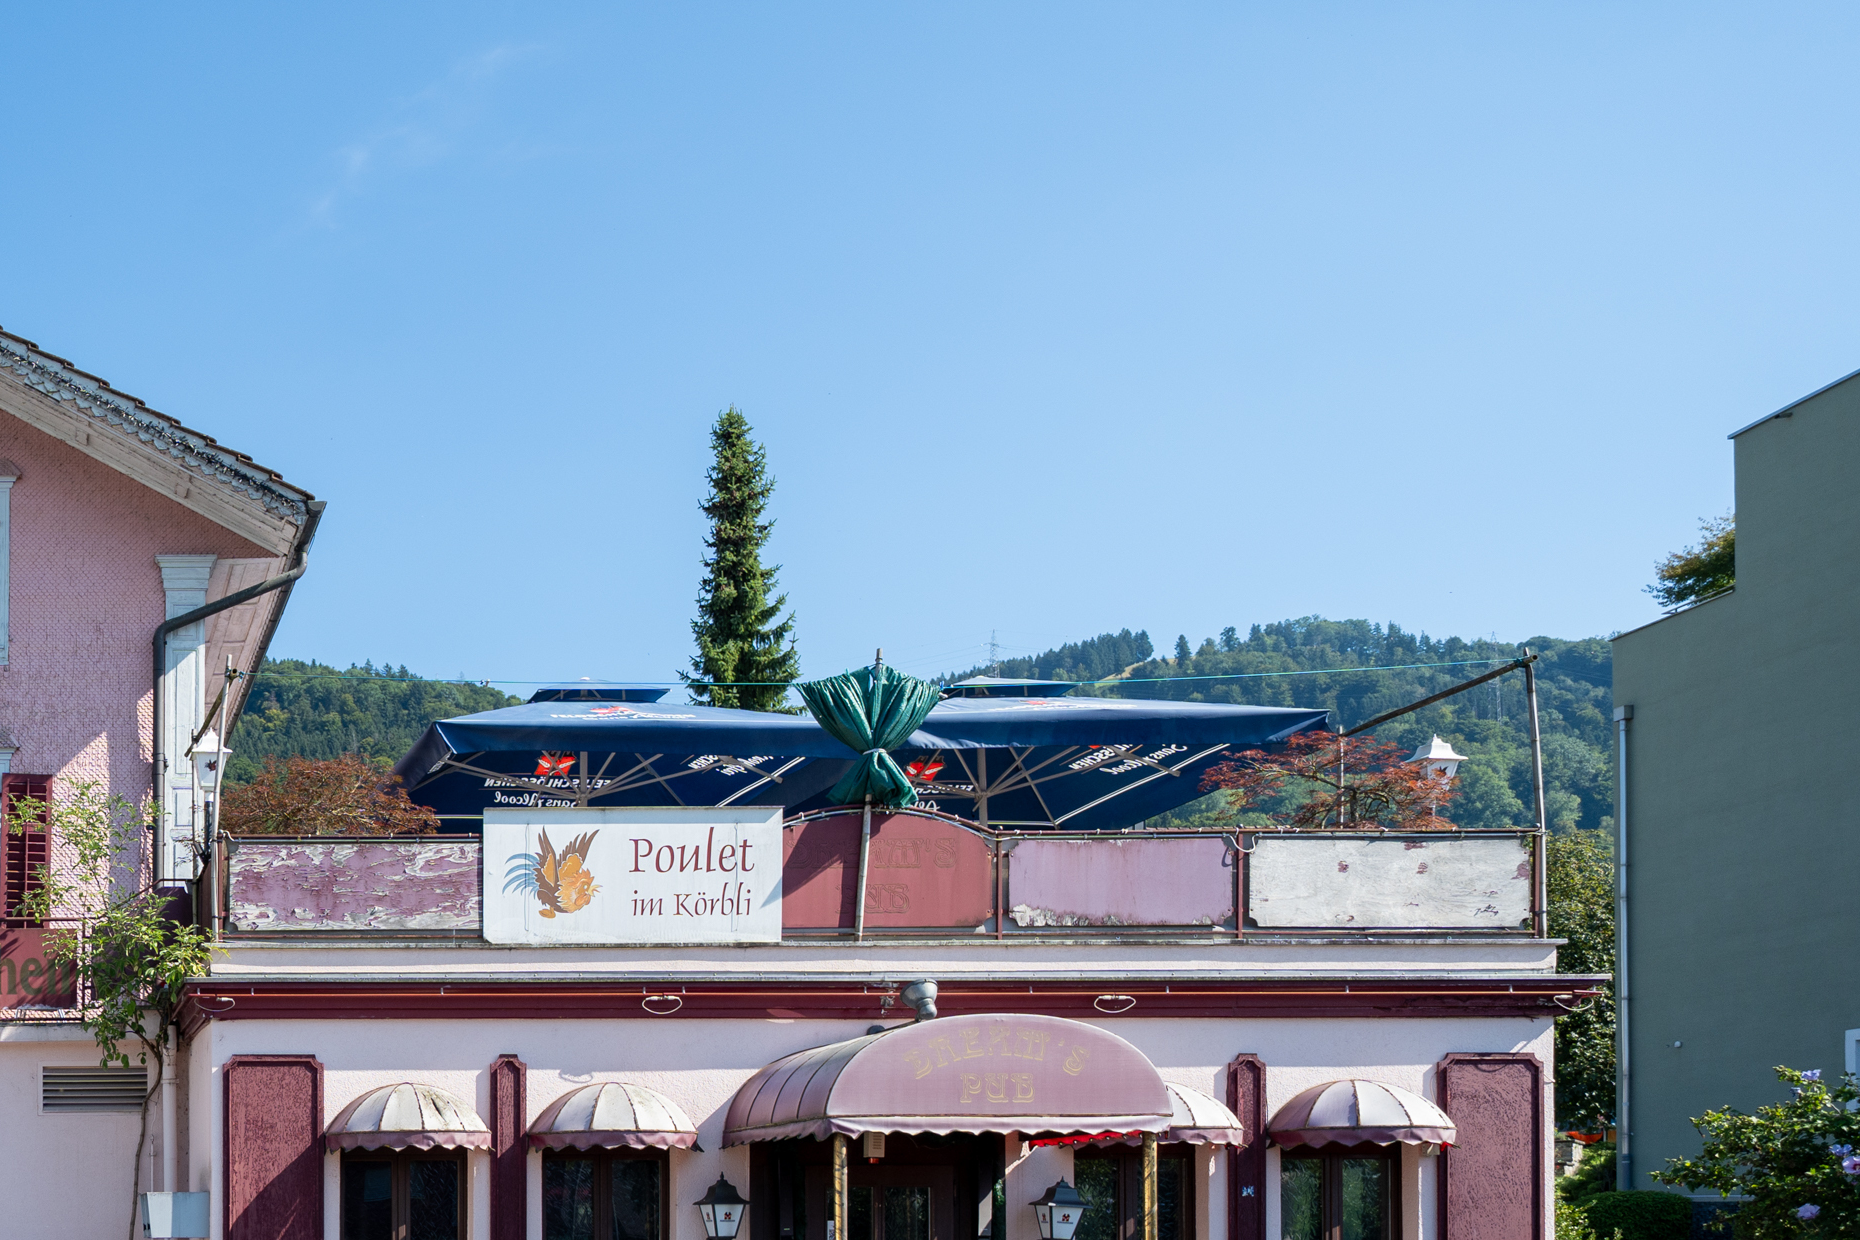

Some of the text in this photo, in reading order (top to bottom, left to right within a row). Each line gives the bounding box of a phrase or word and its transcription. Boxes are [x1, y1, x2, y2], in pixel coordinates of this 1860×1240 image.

[629, 826, 755, 873] Poulet
[631, 882, 751, 917] im Körbli
[960, 1073, 1035, 1103] PUB
